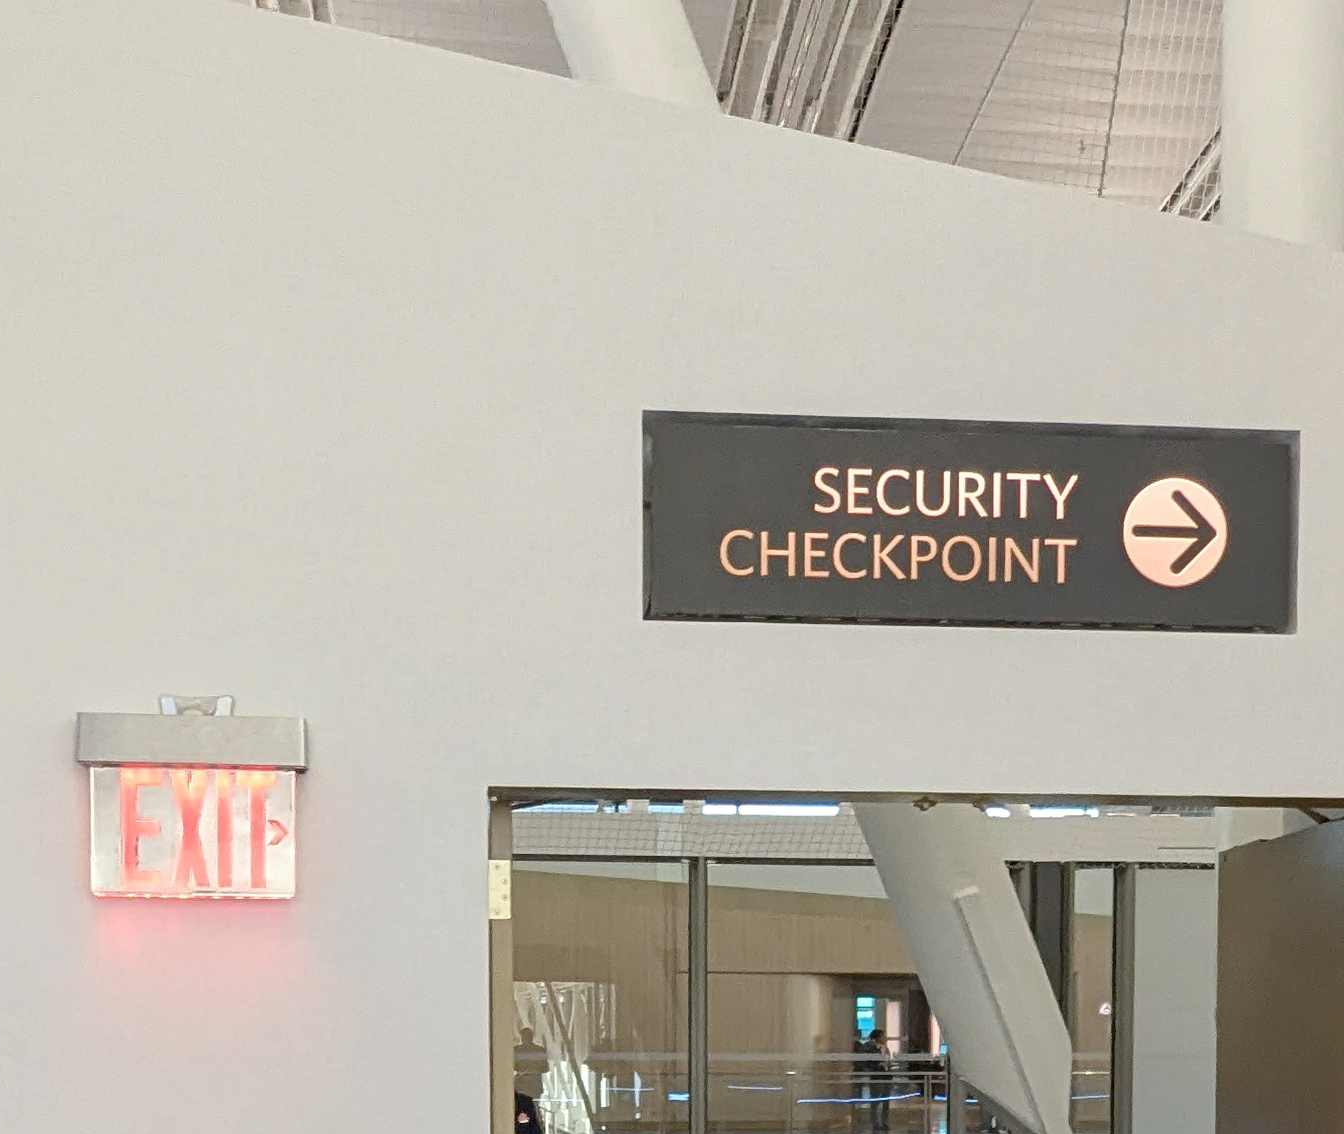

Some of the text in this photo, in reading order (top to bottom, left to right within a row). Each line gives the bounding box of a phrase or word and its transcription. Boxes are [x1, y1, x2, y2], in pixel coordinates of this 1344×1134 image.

[813, 466, 1079, 520] SECURITY
[720, 528, 1079, 585] CHECKPOINT
[119, 767, 279, 889] EXIT
